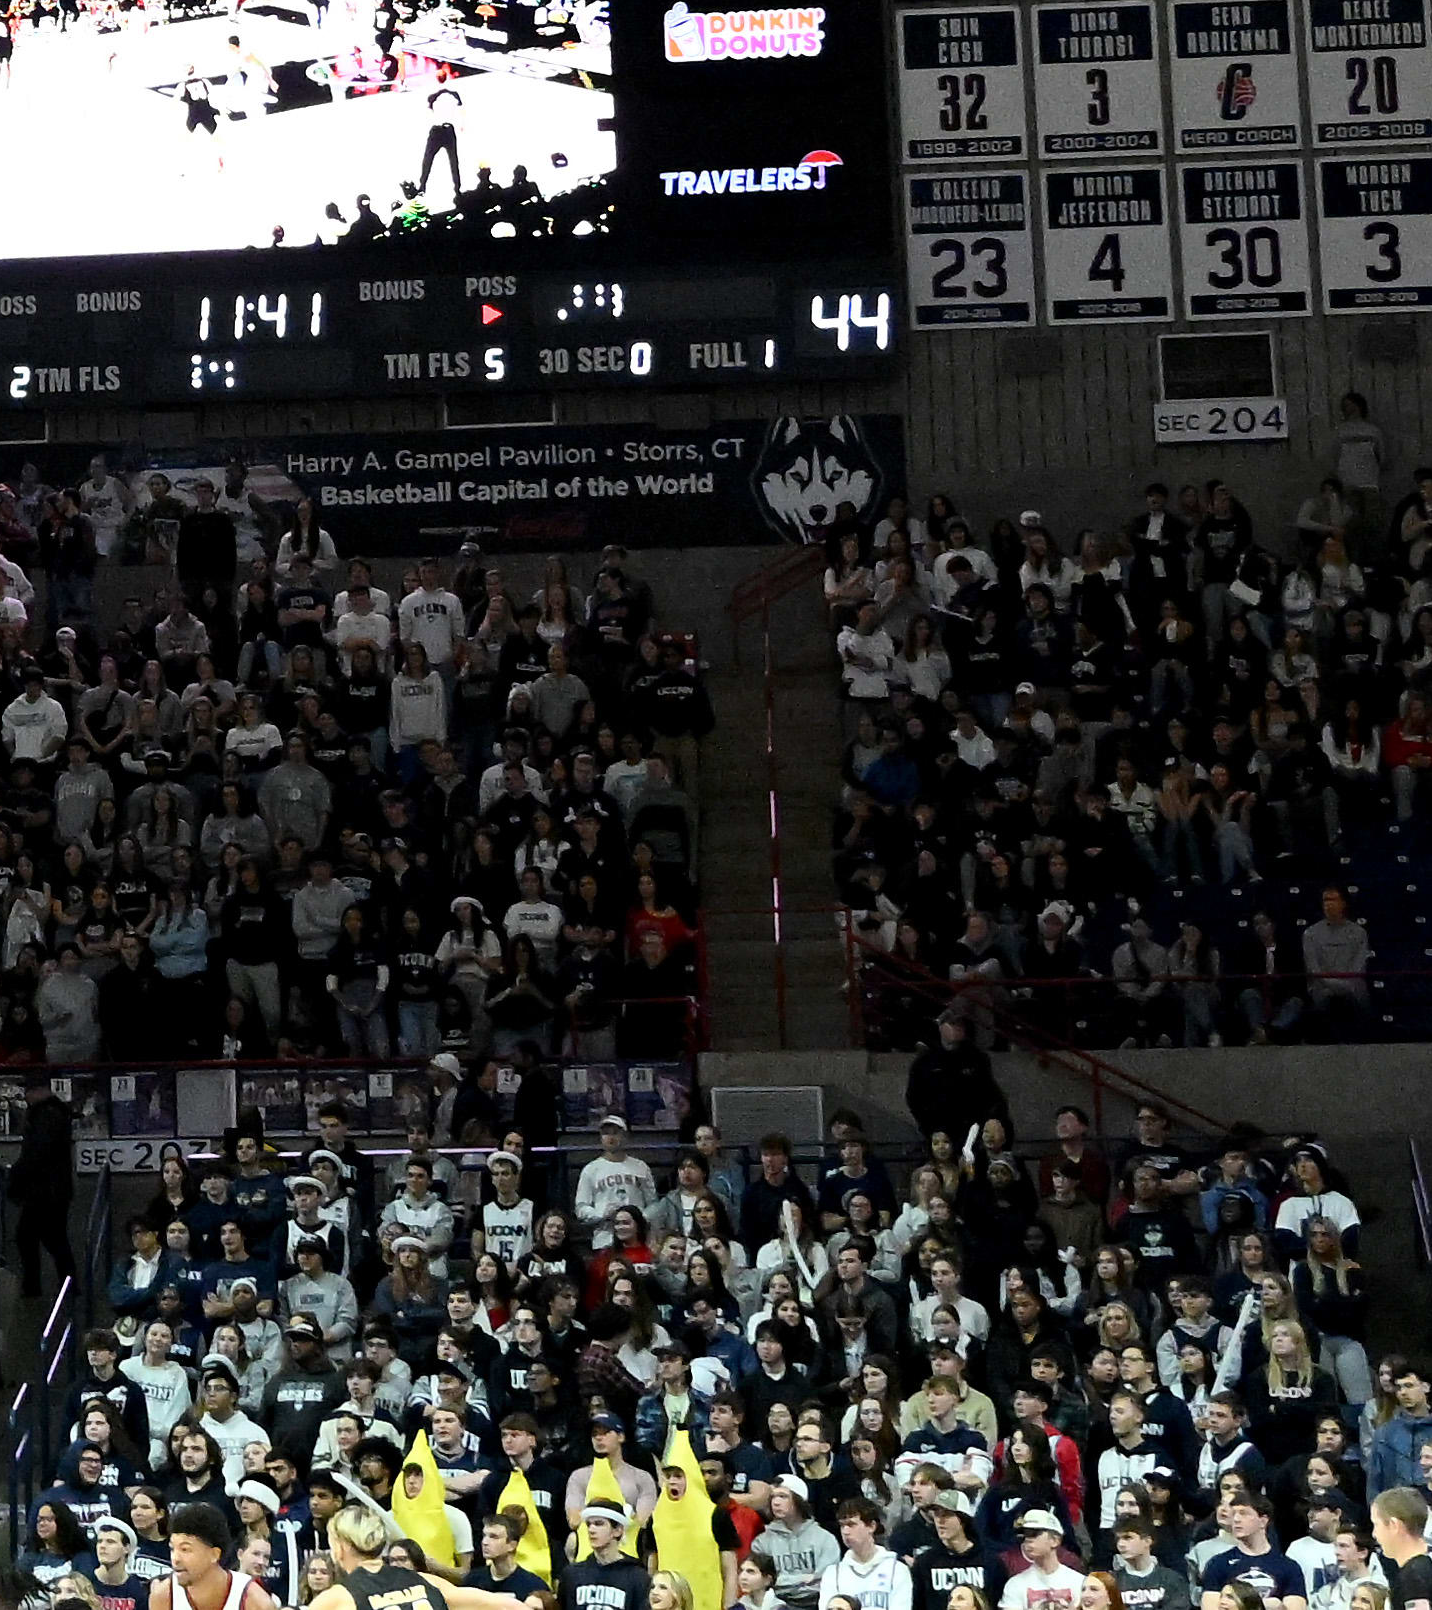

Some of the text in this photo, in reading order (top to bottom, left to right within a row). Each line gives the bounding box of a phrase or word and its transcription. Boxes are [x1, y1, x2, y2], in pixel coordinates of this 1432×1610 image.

[710, 10, 822, 34] DUNKIN'
[710, 32, 817, 55] DONUTS
[1086, 68, 1110, 126] 3
[1345, 56, 1398, 115] 20
[938, 73, 988, 131] 32
[1235, 128, 1294, 143] COACH
[659, 166, 812, 196] TRAVELERS
[1088, 233, 1125, 292] 4
[1206, 226, 1281, 290] 30
[1363, 221, 1401, 283] 3
[930, 237, 1007, 298] 23
[358, 279, 425, 302] BONUS
[465, 275, 517, 297] POSS
[76, 291, 141, 312] BONUS
[199, 292, 322, 341] 11:41
[811, 292, 889, 351] 44
[383, 352, 471, 379] TM FLS
[484, 347, 506, 380] 5
[539, 345, 625, 374] 30 SEC
[629, 341, 652, 376] 0
[689, 341, 747, 369] FULL
[10, 366, 31, 398] 2
[35, 366, 120, 394] TM FLS
[1158, 406, 1284, 434] SEC 204
[286, 438, 745, 477] Harry A. Gampel Pavilion Storrs, CT
[321, 472, 714, 507] Basketball Capital of the World
[80, 1148, 123, 1166] SEC
[486, 1224, 529, 1238] UCONN
[499, 1239, 514, 1262] 15
[931, 1566, 985, 1590] UCONN
[575, 1585, 626, 1606] UCONN
